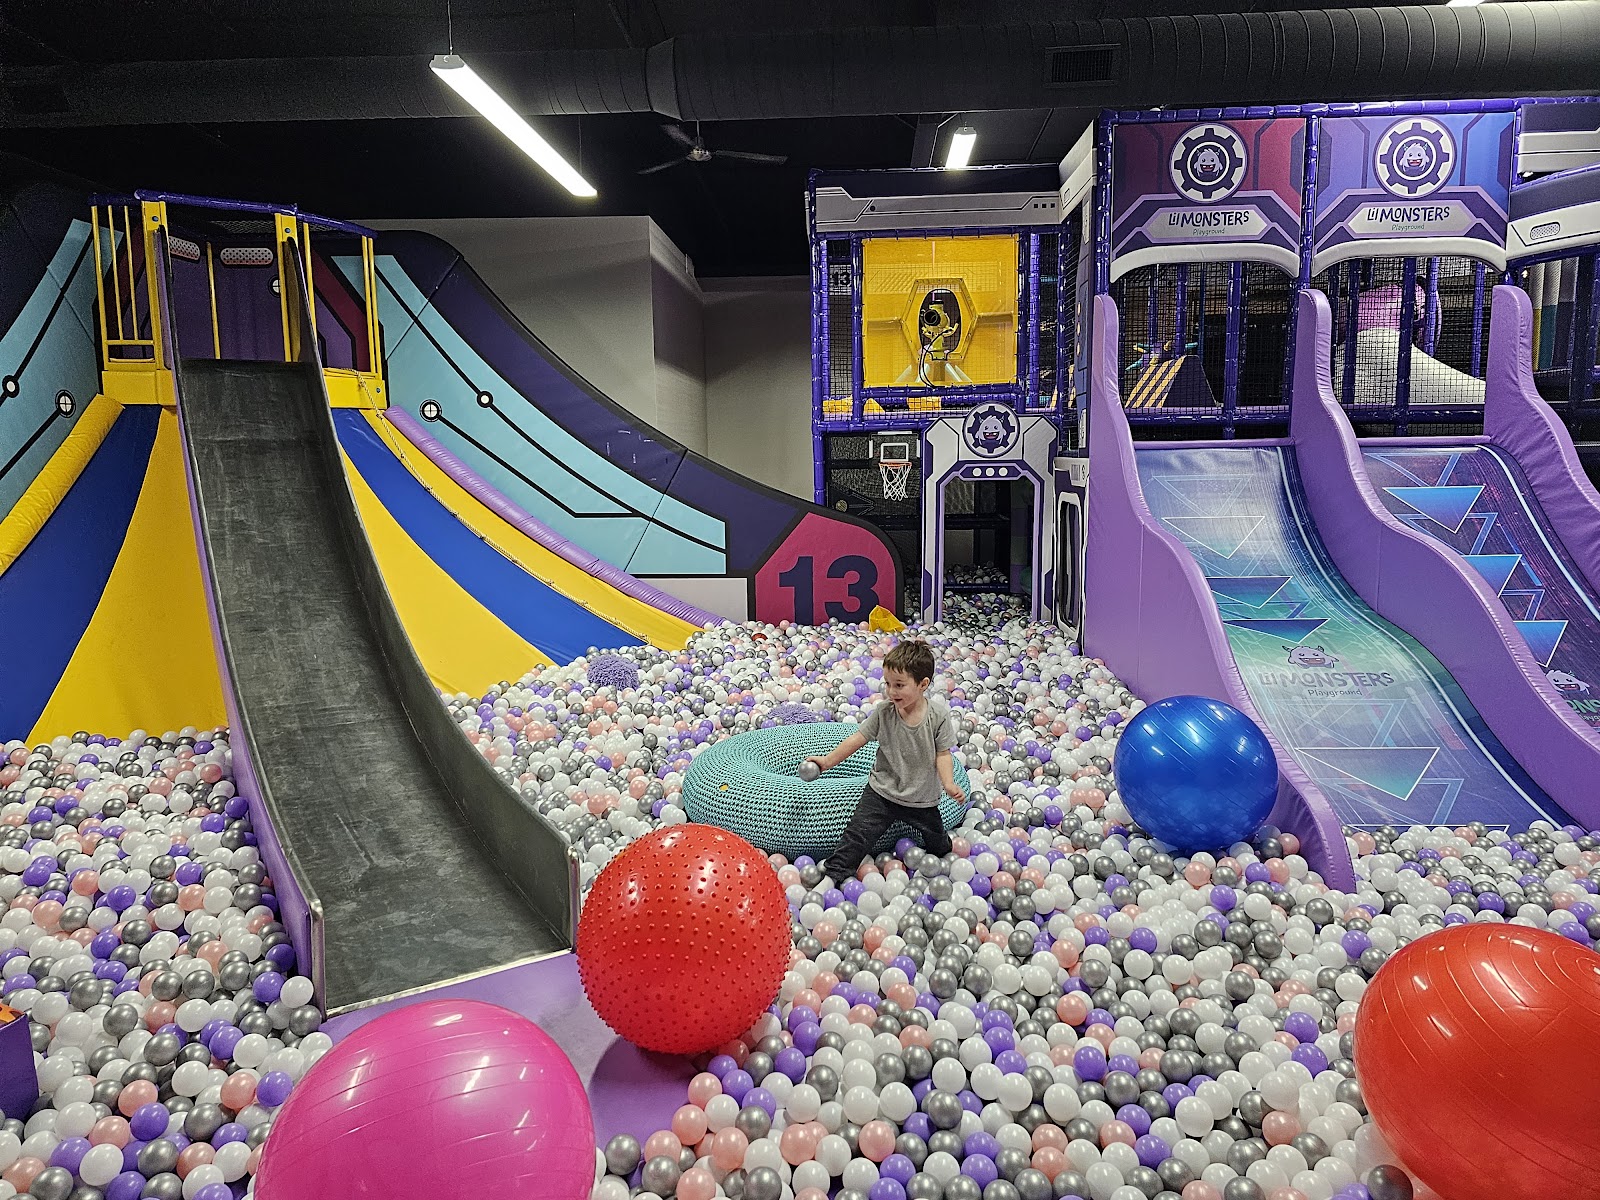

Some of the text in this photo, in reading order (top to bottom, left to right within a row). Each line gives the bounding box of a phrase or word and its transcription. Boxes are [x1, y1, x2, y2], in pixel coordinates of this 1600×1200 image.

[1180, 210, 1250, 227] MONSTERS
[1380, 206, 1450, 222] MONSTERS
[1192, 228, 1226, 237] Playground
[1392, 224, 1425, 232] Playground
[778, 554, 880, 626] 13
[1279, 672, 1395, 688] MONSTERS
[1307, 688, 1363, 698] Playground
